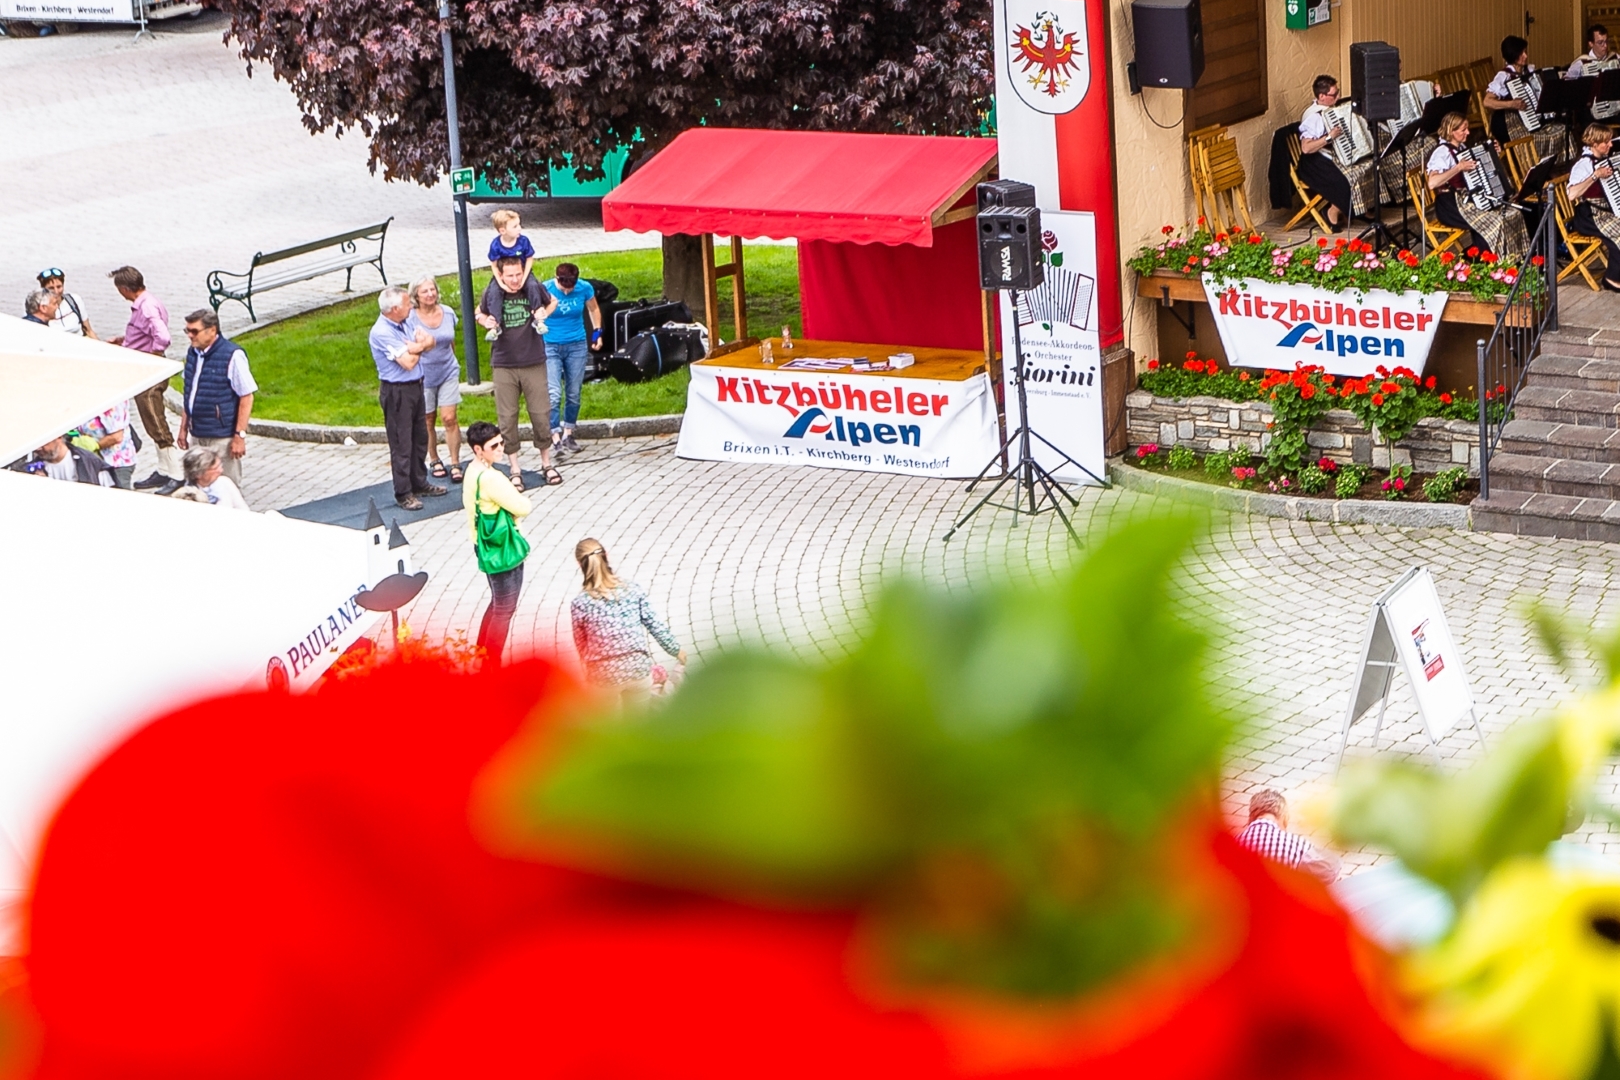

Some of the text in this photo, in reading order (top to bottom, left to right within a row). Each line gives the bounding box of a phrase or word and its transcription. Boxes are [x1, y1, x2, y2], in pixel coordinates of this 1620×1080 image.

[1000, 245, 1012, 281] RAMSA
[1218, 292, 1433, 332] Kitzbüheler
[1034, 350, 1073, 362] Orchester
[1276, 322, 1405, 357] Alpen
[715, 376, 949, 418] Kitzbüheler
[783, 407, 921, 447] Alpen
[724, 440, 770, 455] Brixen
[807, 447, 871, 465] Kirchberg
[883, 456, 950, 469] Westendorf
